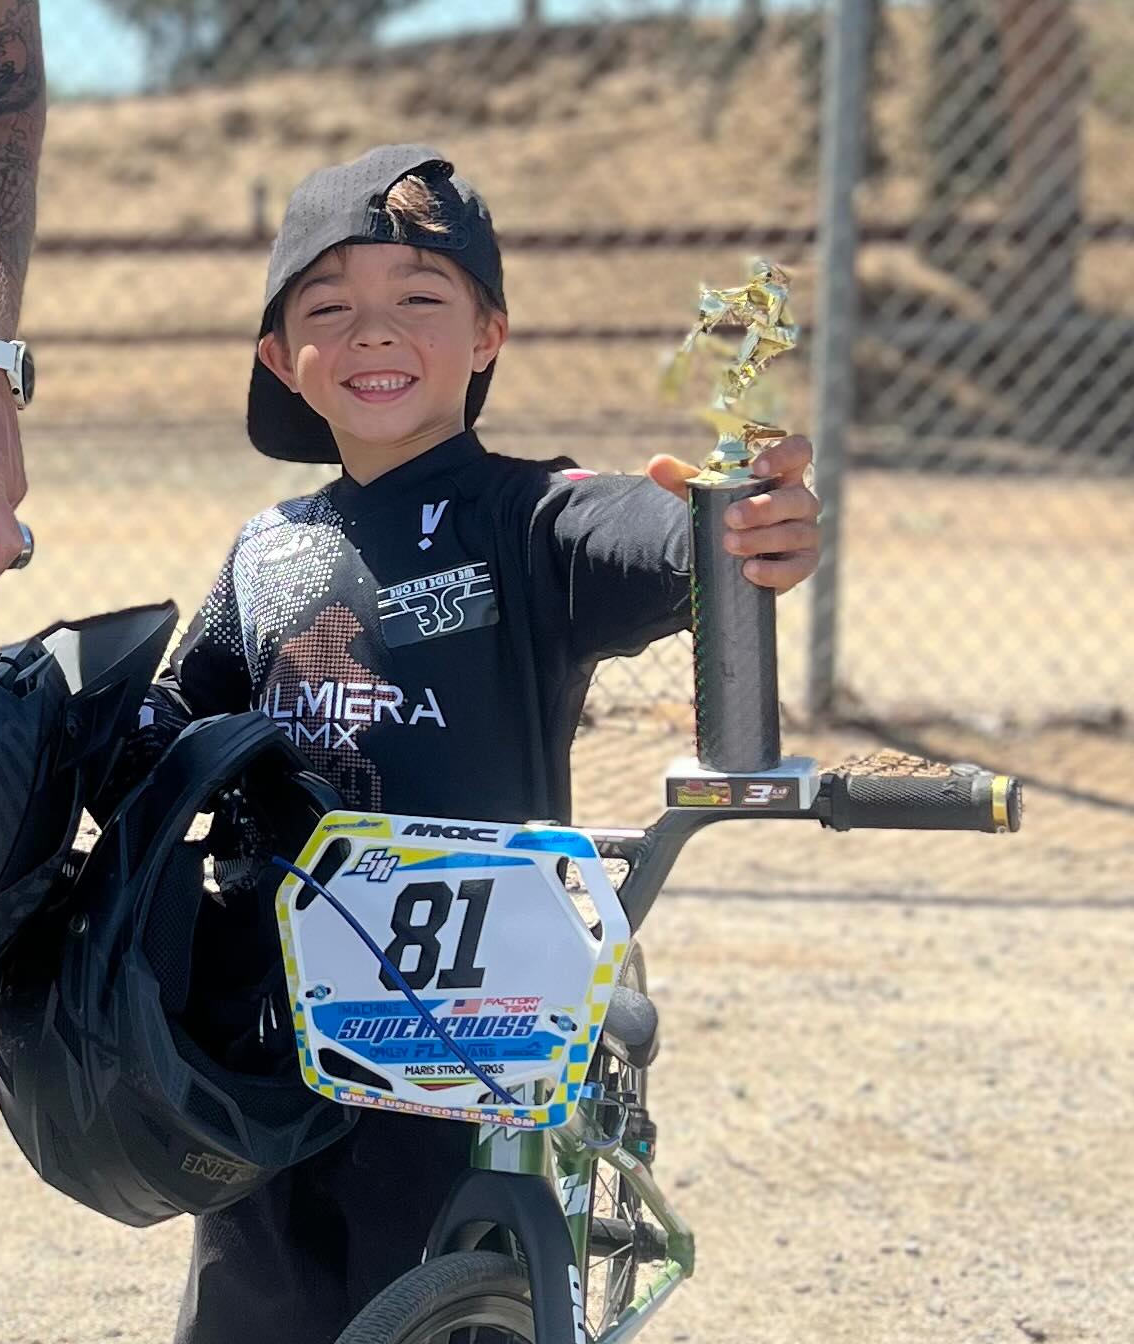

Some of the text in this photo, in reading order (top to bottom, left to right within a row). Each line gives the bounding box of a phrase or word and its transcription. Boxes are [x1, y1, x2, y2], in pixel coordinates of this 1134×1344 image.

[458, 567, 476, 579] WE
[429, 572, 456, 587] RIDE
[379, 878, 496, 992] 81
[483, 997, 543, 1006] FACTORY
[503, 1005, 538, 1014] TEAM
[405, 1065, 436, 1075] MARIS
